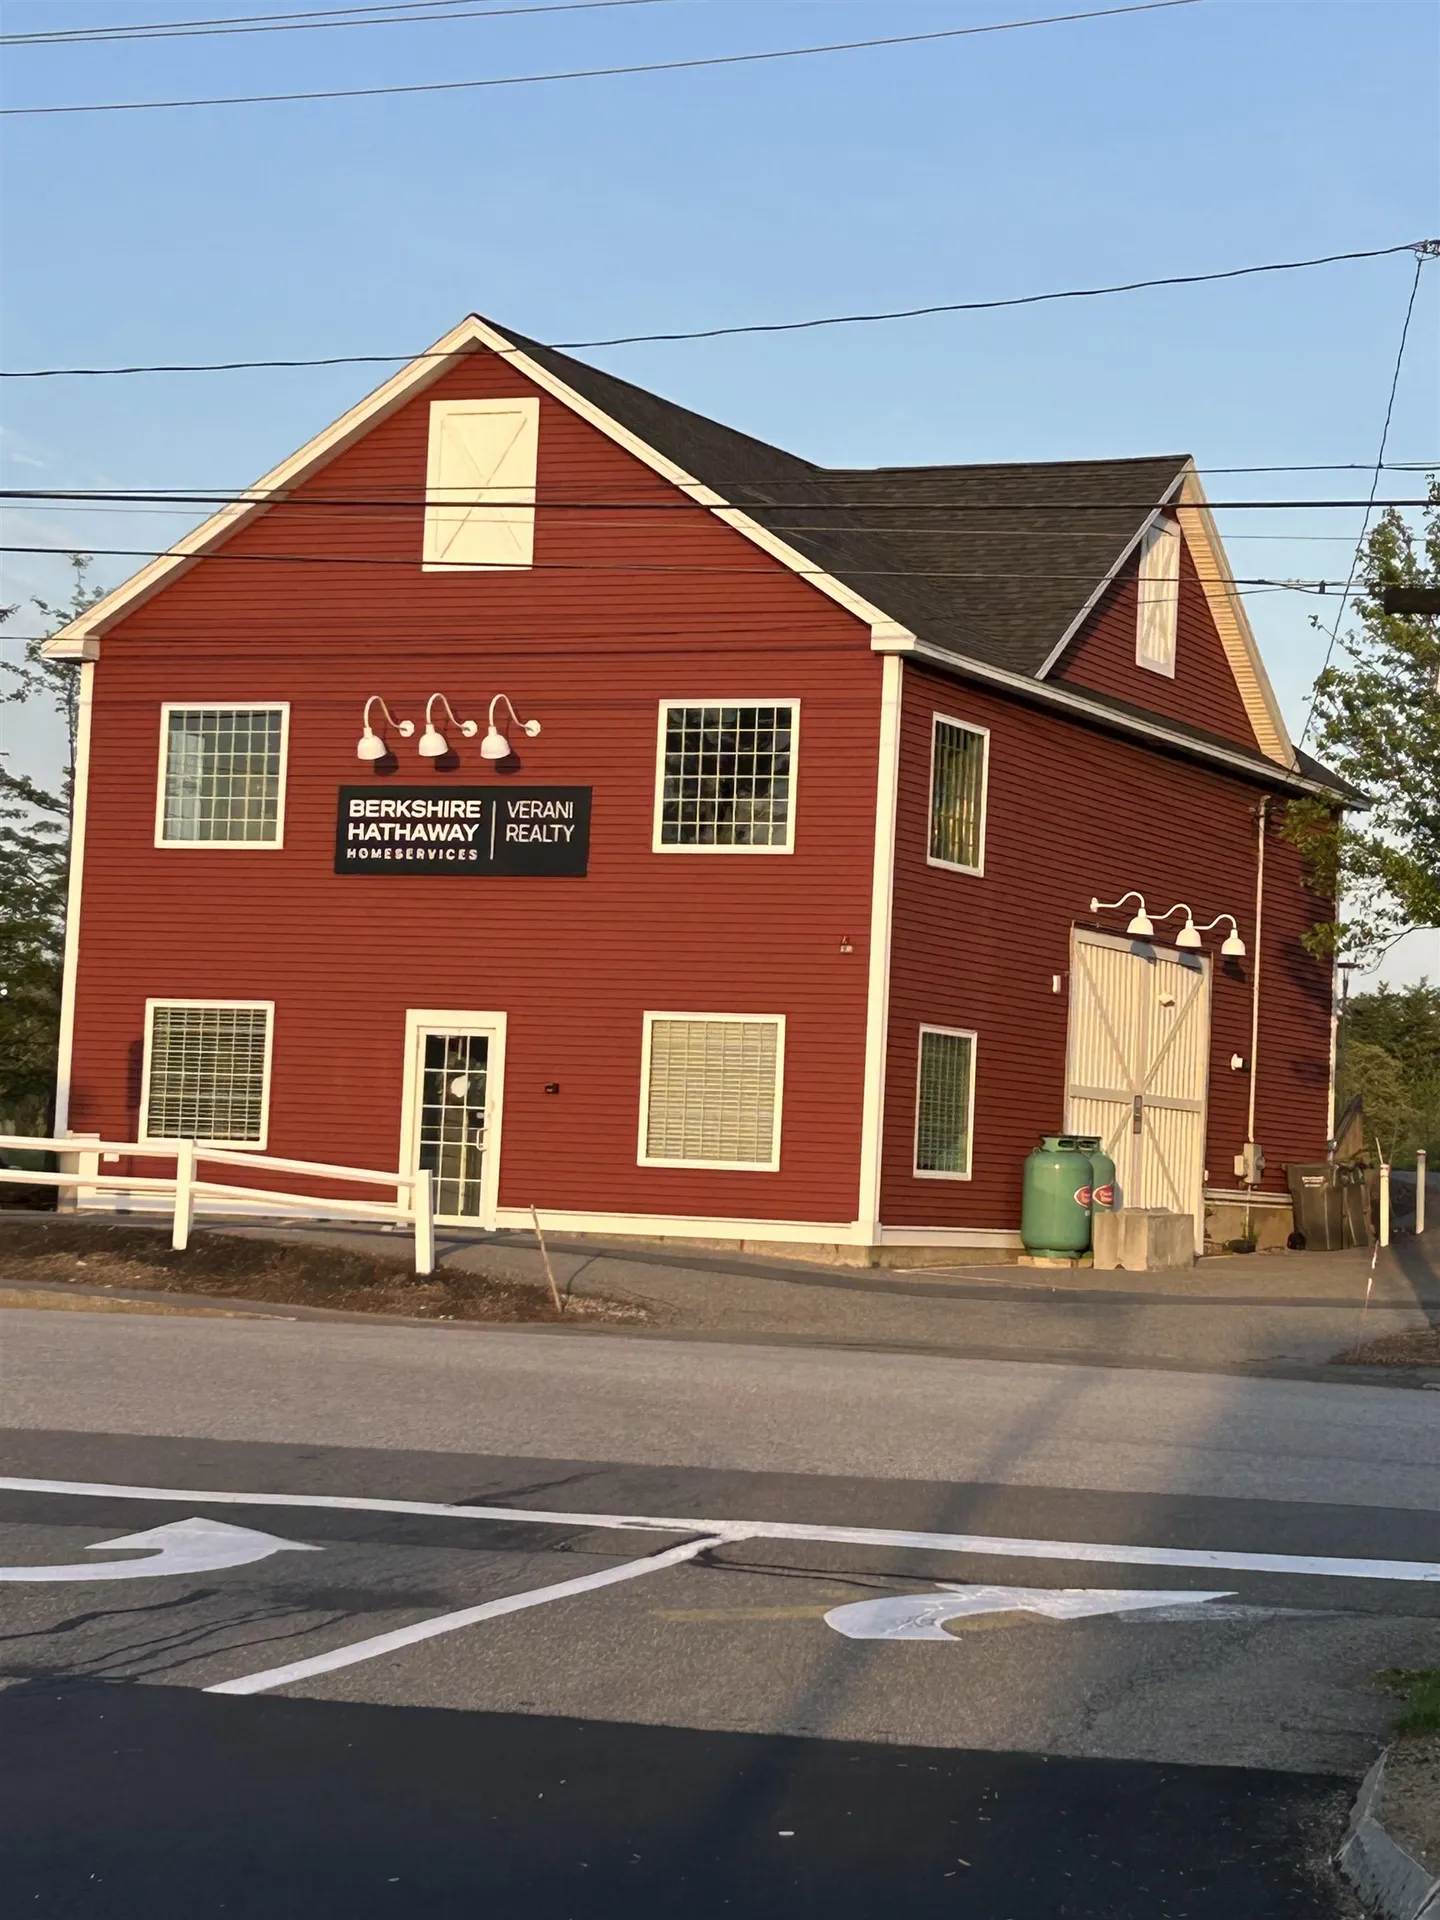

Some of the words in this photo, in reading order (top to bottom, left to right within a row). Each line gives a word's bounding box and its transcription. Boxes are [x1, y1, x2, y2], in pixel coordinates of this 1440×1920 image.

[349, 799, 482, 819] BERKSHIRE
[506, 800, 574, 819] VERANI
[347, 822, 480, 842] HATHAWAY
[505, 823, 575, 843] REALTY
[346, 847, 478, 861] HOMESERVICES
